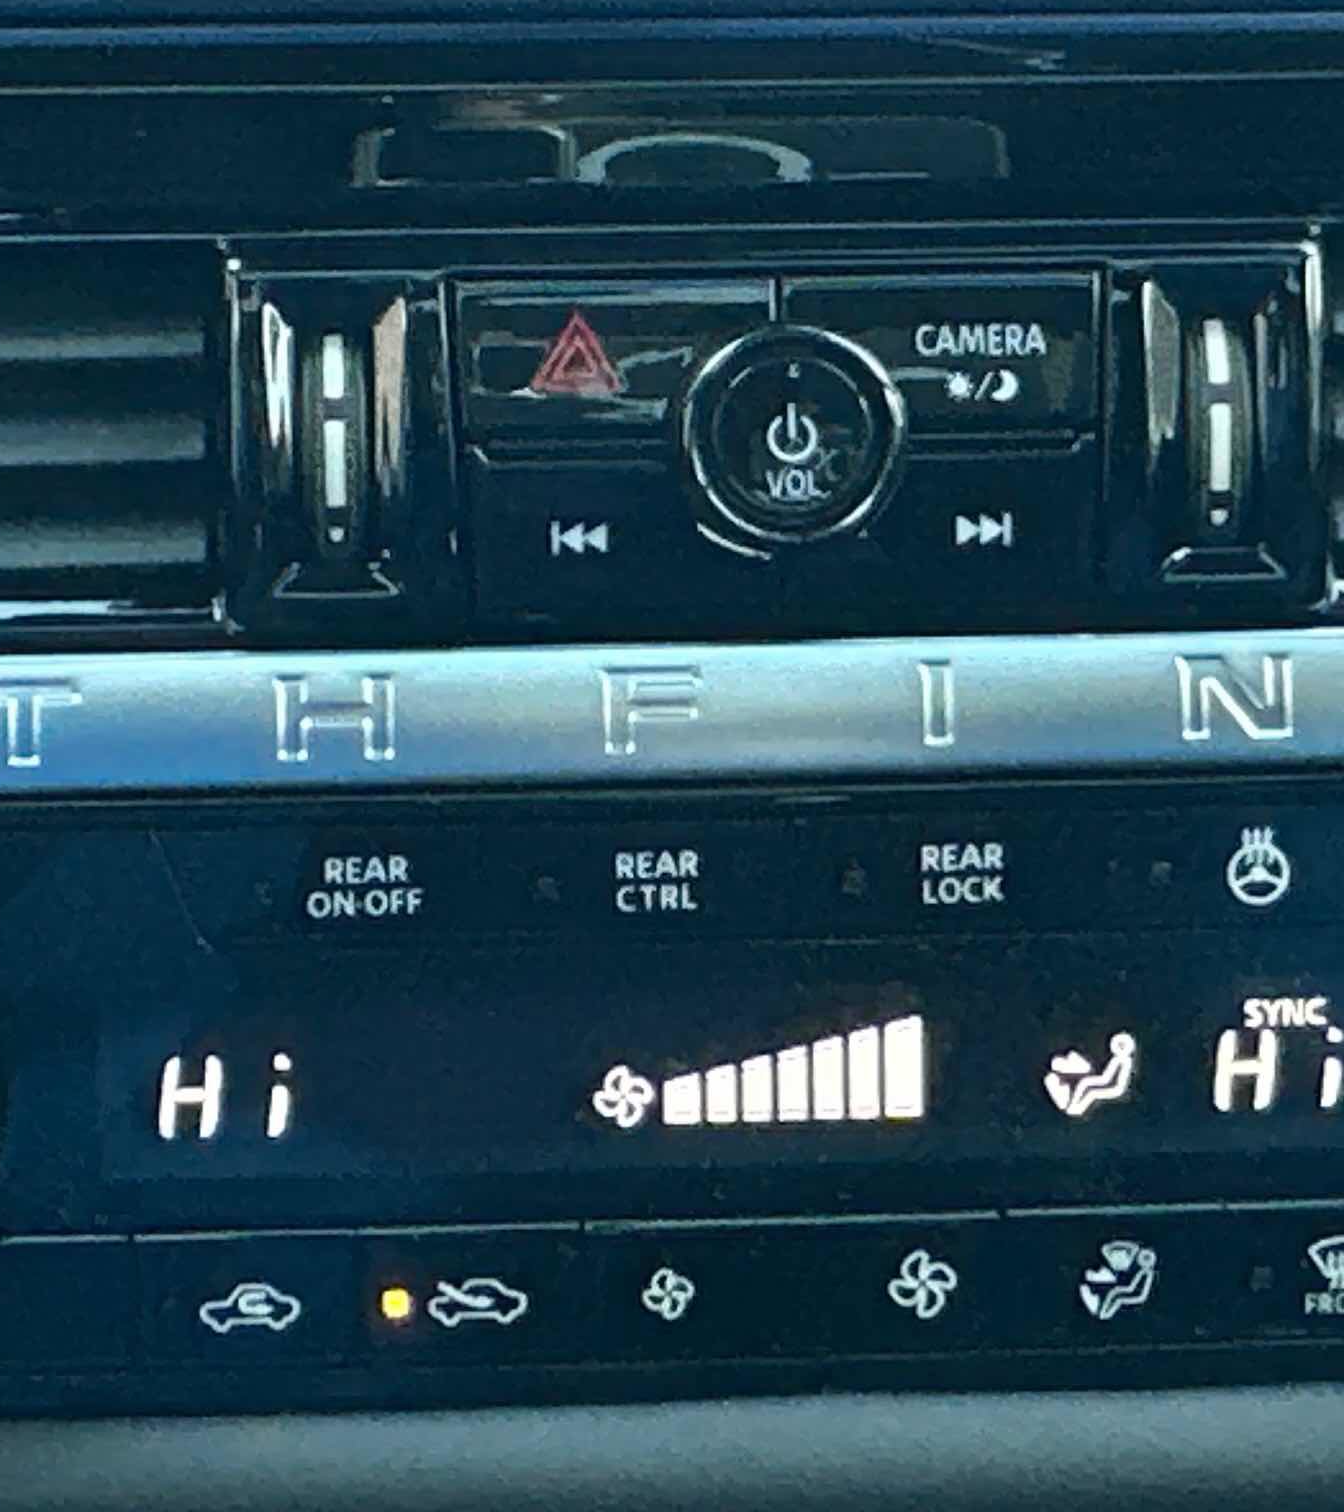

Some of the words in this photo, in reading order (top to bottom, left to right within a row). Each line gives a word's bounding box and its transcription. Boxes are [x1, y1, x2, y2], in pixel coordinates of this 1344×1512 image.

[915, 323, 1046, 356] CAMERA
[766, 469, 821, 498] VOL
[324, 855, 408, 884] REAR
[615, 850, 699, 879] REAR
[920, 843, 1004, 872] REAR
[615, 884, 697, 912] CTRL
[921, 876, 1004, 905] LOCK
[1243, 995, 1328, 1028] SYNC
